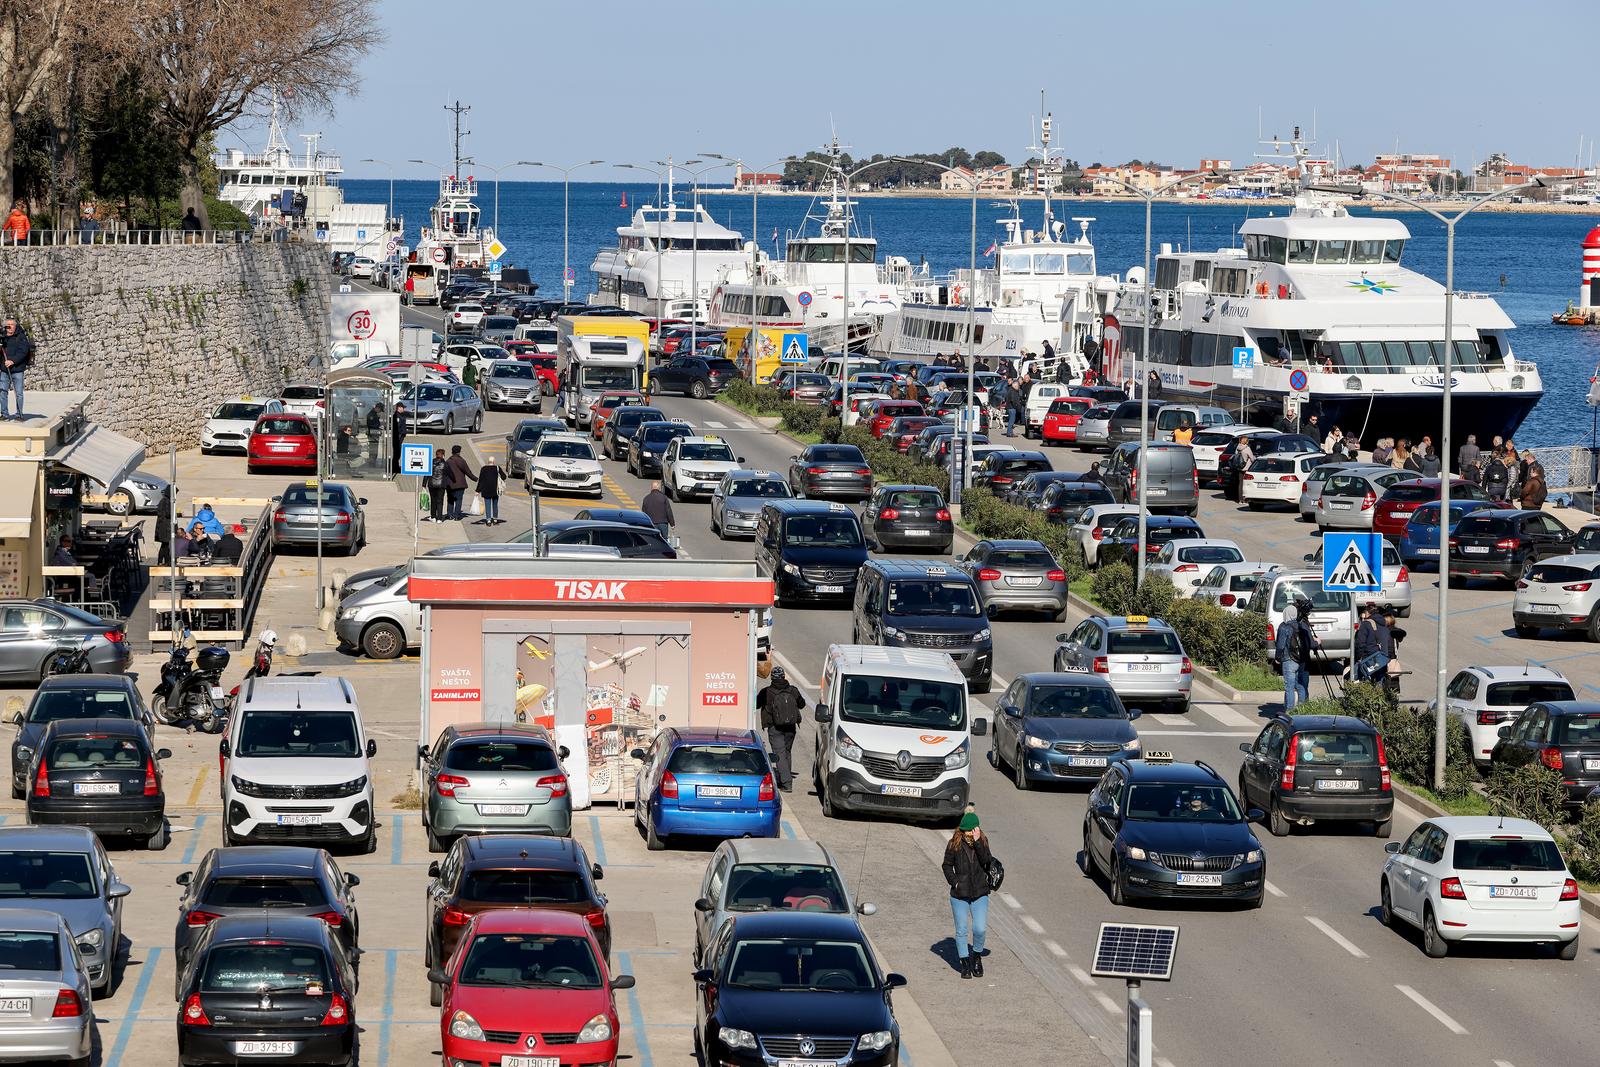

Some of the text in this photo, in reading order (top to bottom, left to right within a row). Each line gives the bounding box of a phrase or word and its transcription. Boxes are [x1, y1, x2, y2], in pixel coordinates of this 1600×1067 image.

[355, 317, 370, 329] 30
[1239, 352, 1248, 364] P
[554, 581, 628, 600] TISAK
[704, 672, 736, 680] SVAŠTA
[442, 677, 470, 685] NEŠTO
[706, 681, 735, 689] NEŠTO
[705, 695, 735, 703] TISAK
[261, 1042, 293, 1051] 379-FS
